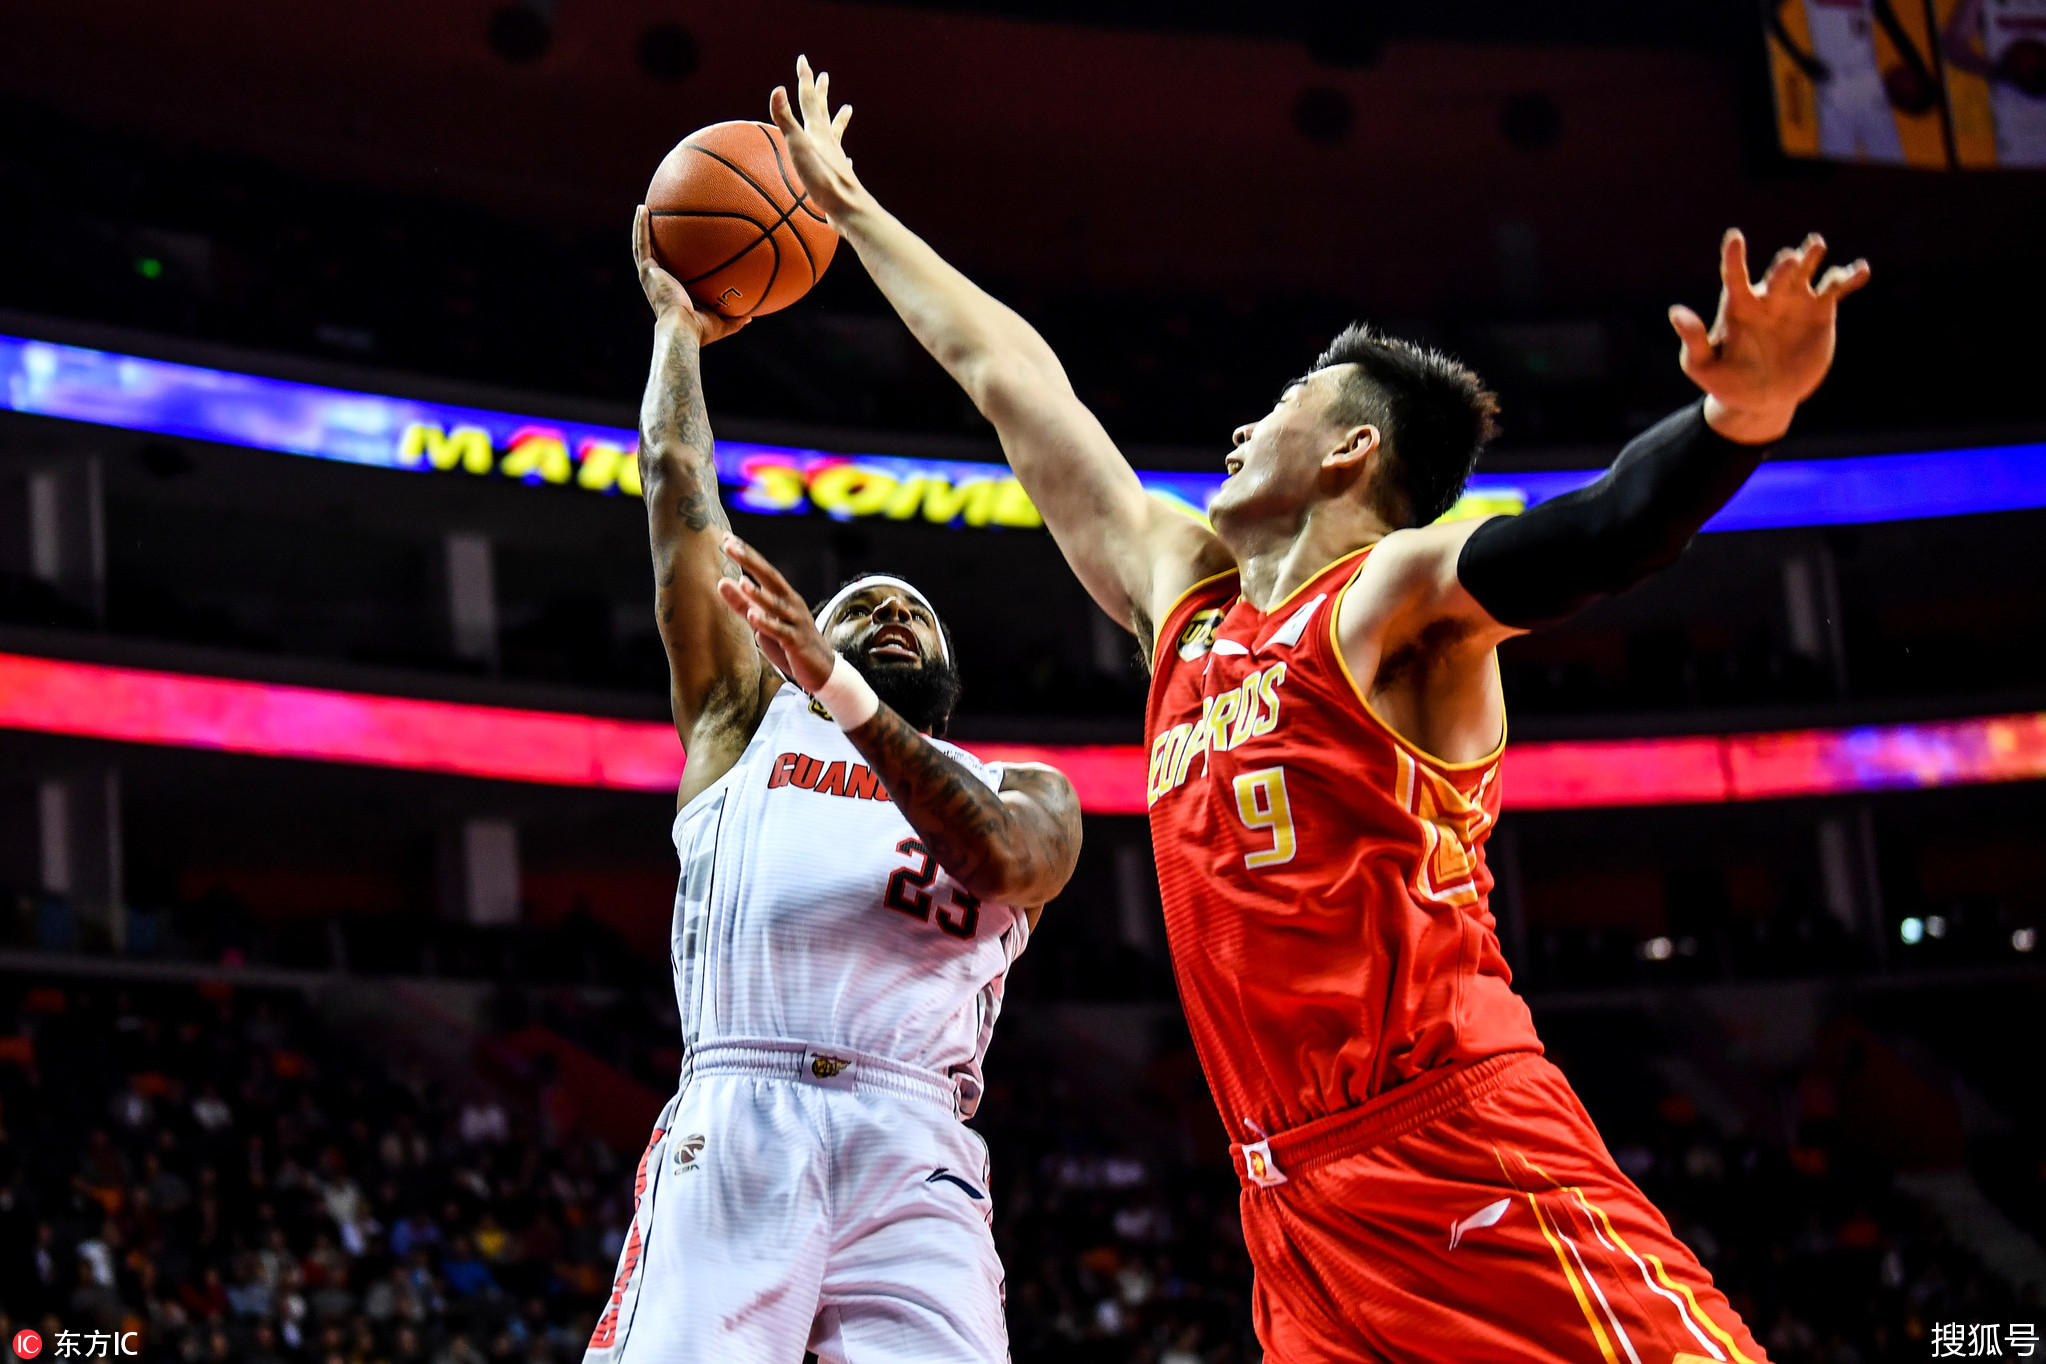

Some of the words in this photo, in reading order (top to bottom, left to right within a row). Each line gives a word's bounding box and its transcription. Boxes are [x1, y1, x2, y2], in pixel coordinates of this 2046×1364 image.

[400, 423, 642, 496] MAK
[768, 752, 893, 802] GUAN
[1232, 765, 1297, 870] 9
[883, 836, 981, 941] 23
